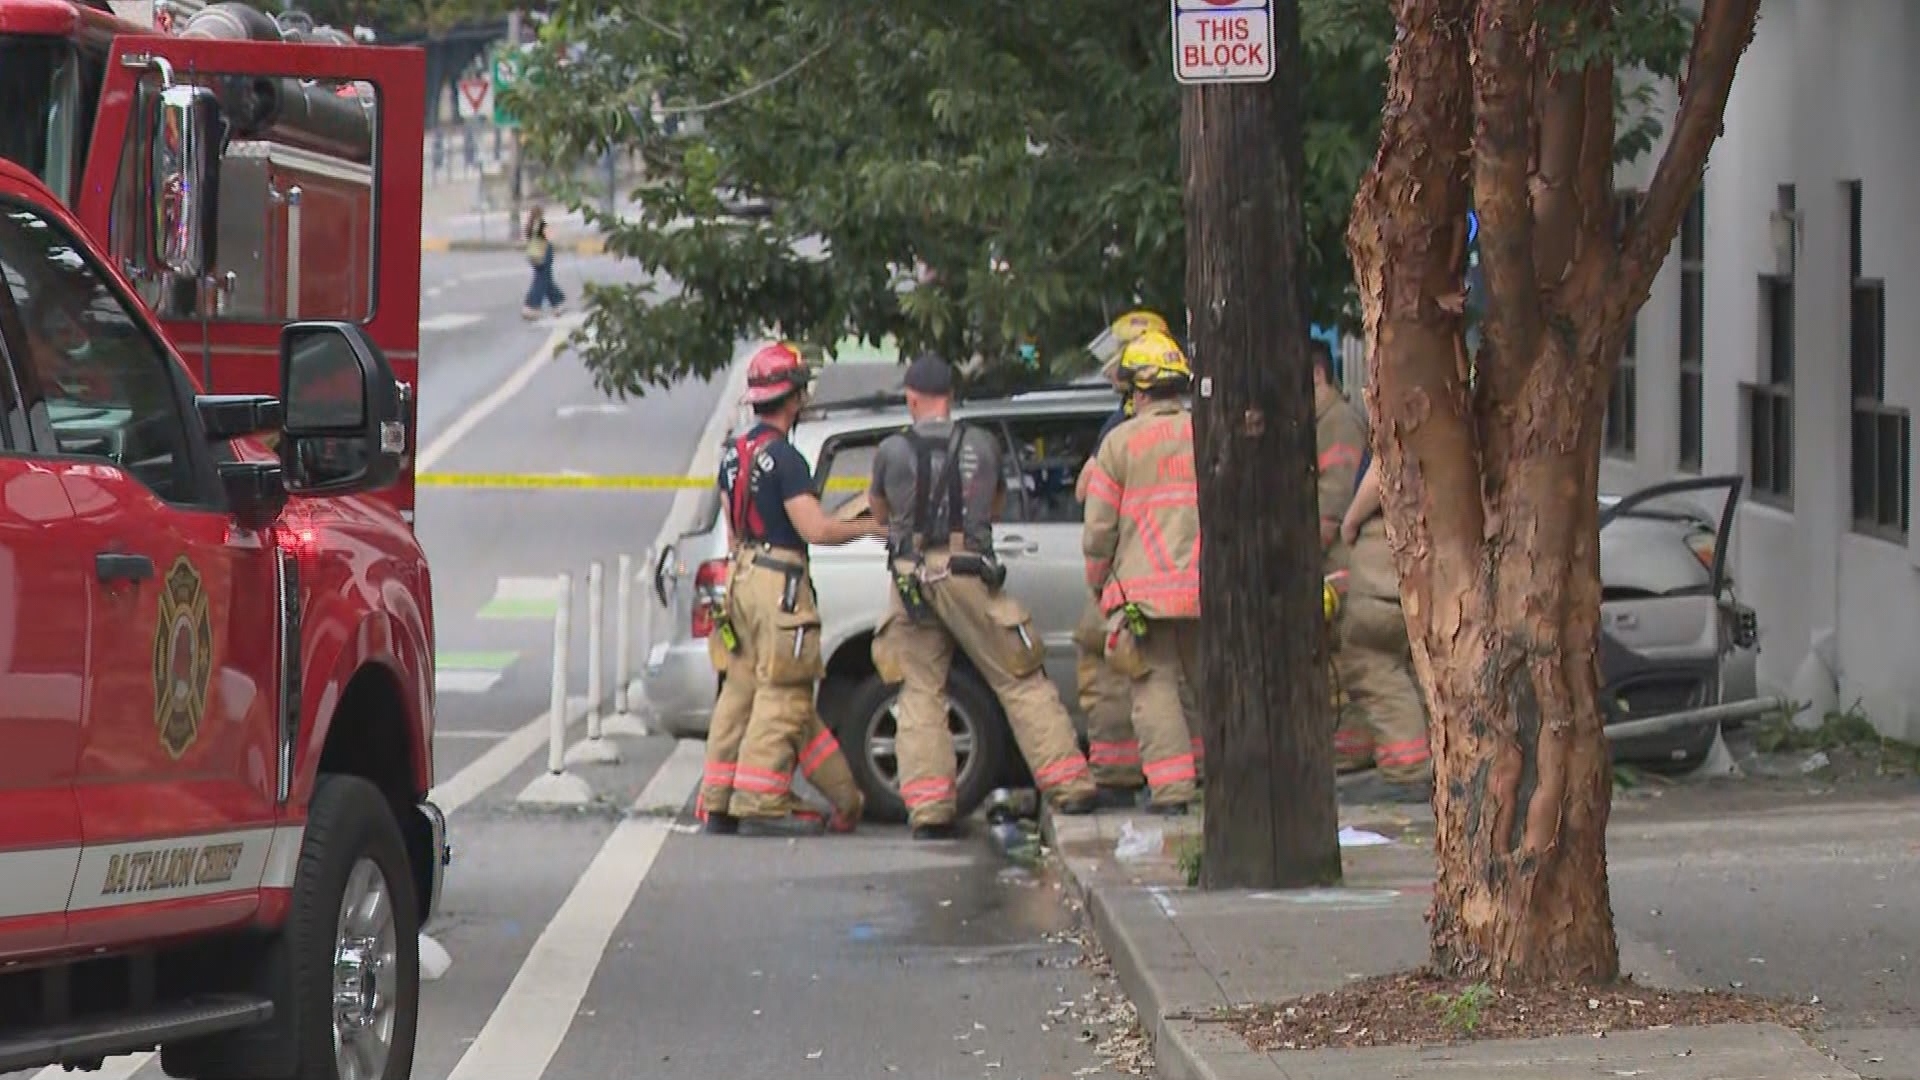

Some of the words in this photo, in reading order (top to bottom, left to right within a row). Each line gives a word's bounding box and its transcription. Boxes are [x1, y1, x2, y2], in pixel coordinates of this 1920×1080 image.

[1196, 18, 1249, 41] THIS
[1184, 43, 1264, 67] BLOCK
[102, 848, 199, 894] BATTALION
[194, 842, 244, 885] CHIEF
